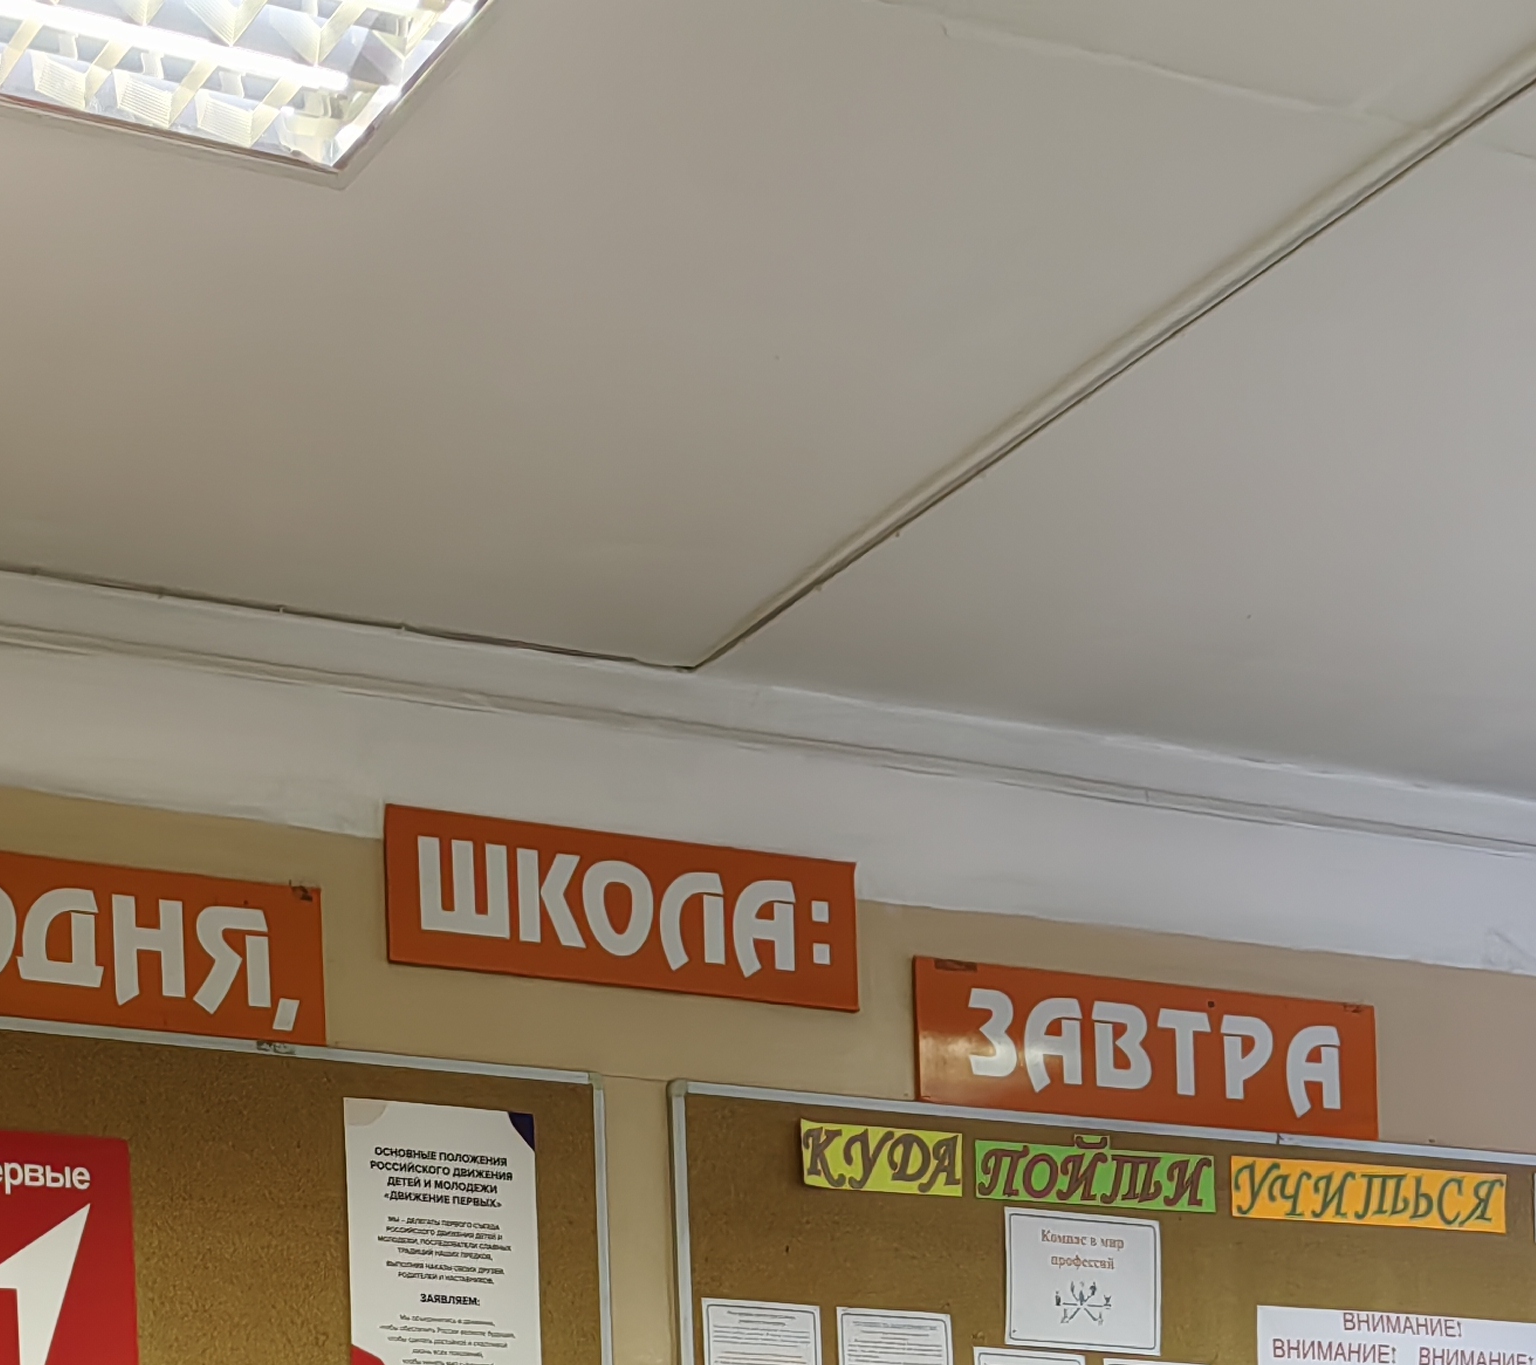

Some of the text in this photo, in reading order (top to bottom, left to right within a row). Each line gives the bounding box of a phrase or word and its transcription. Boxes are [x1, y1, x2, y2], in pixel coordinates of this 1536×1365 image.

[418, 835, 832, 979] ШКОЛА:
[967, 987, 1343, 1118] ЗАВТРА
[375, 1147, 507, 1166] ОСНОВНЫЕ ПОЛОЖЕНИЯ
[370, 1161, 512, 1180] РОССИЙСКОГО ДВИЖЕНИЯ
[802, 1126, 1505, 1226] КУДА ПОЙТИ УЧИТЬСЯ
[387, 1177, 497, 1194] ДЕТЕЙ И МОЛОДЕЖИ
[384, 1191, 502, 1207] «ДВИЖЕНИЕ ПЕРВЫХ»
[1091, 1237, 1097, 1246] в
[420, 1294, 480, 1306] ЗАЯВЛЯЕМ:
[1343, 1312, 1462, 1338] ВНИМАНИЕ!
[1273, 1338, 1396, 1364] ВНИМАНИЕ!
